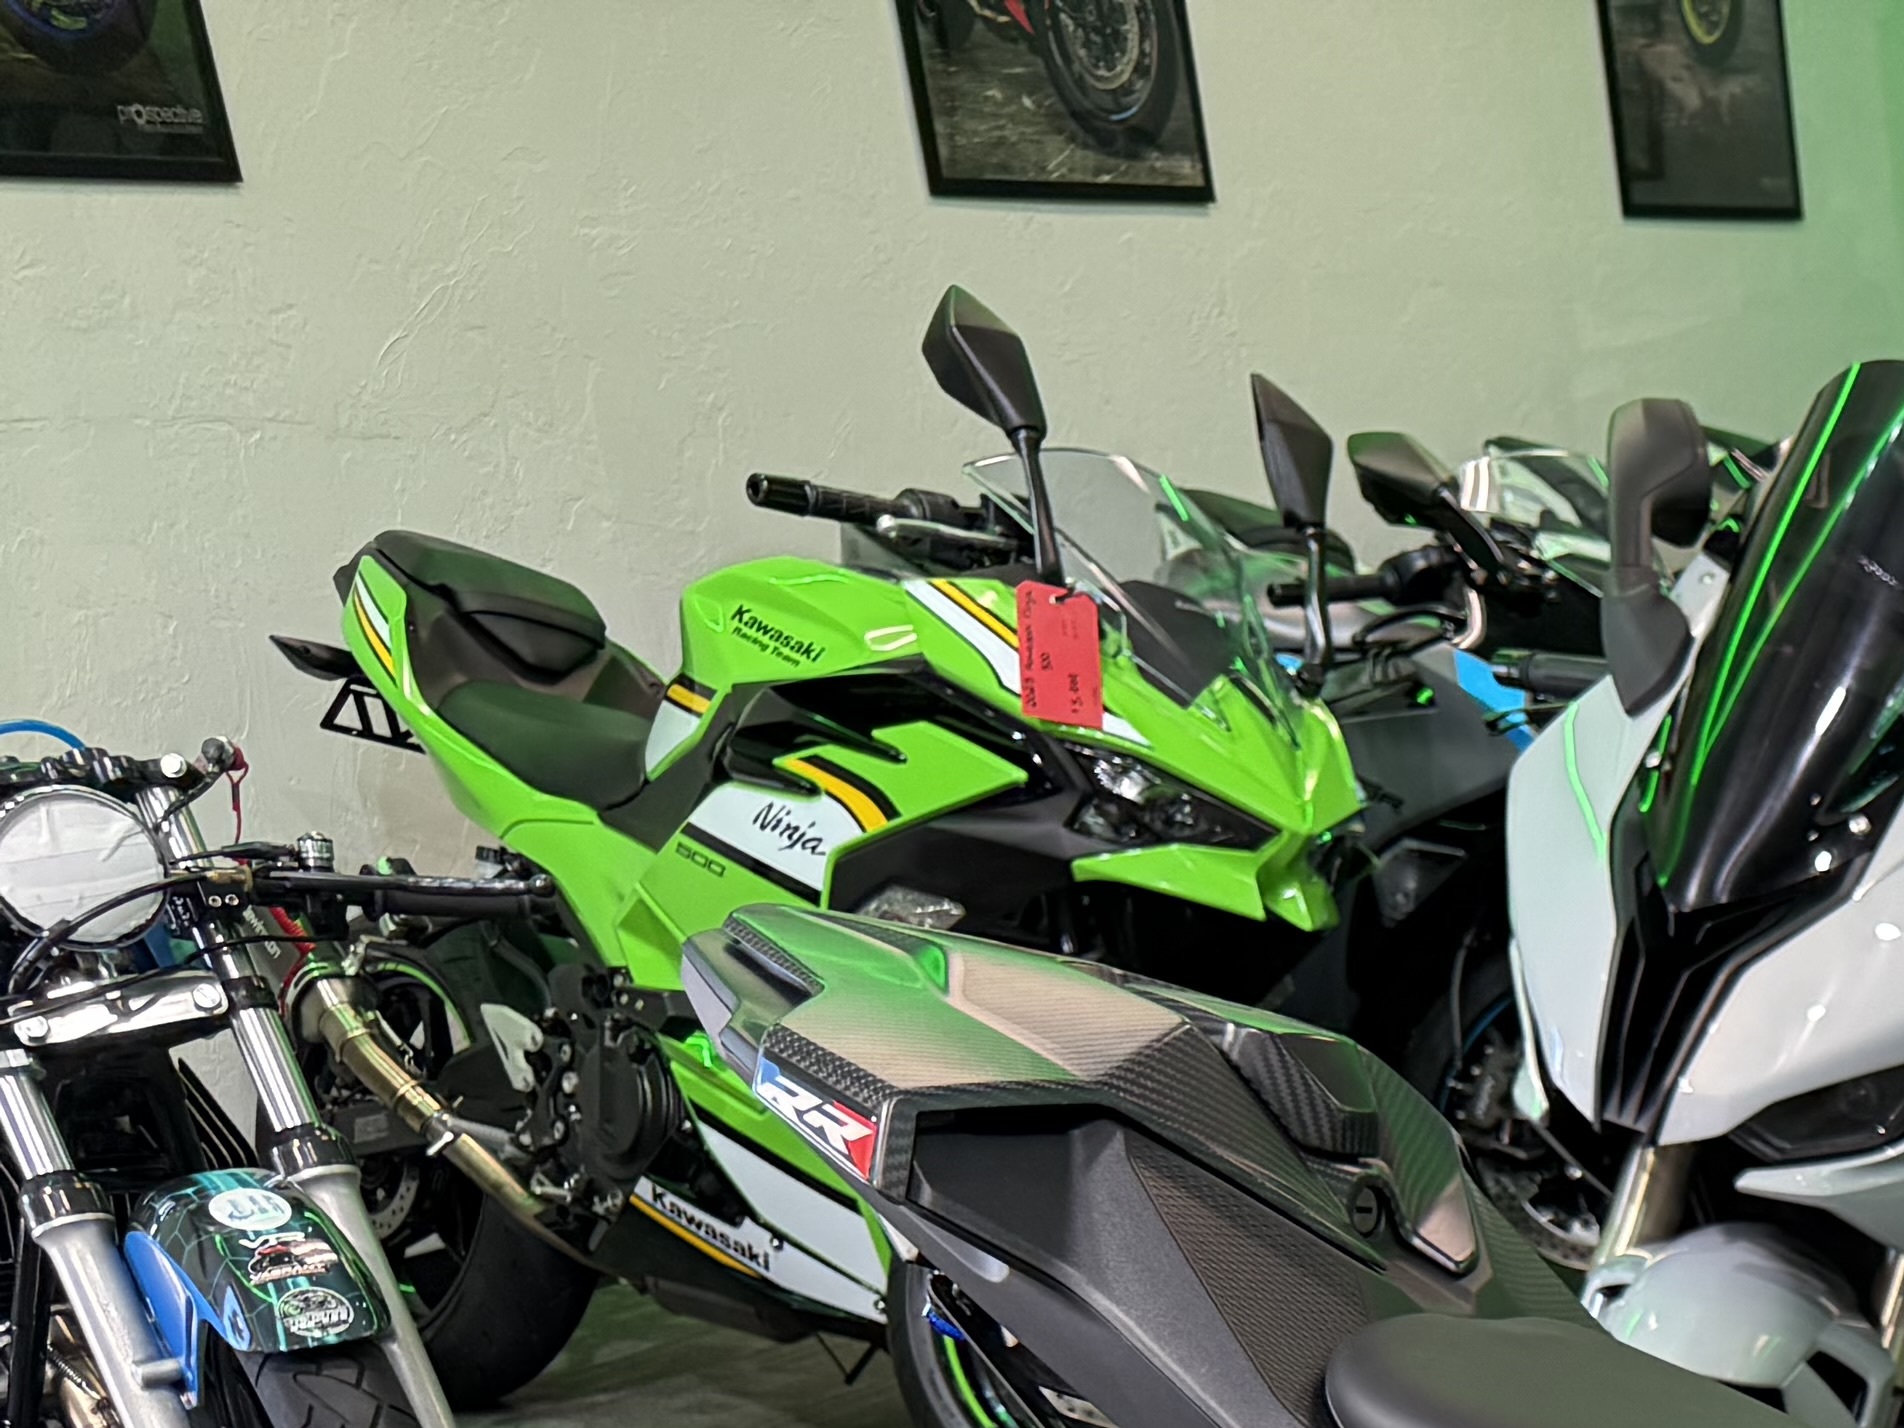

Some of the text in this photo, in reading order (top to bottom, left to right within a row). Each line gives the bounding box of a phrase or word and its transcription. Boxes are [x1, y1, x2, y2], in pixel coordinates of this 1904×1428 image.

[730, 604, 826, 664] Kawasaki
[731, 626, 801, 668] Racing Team
[752, 800, 828, 856] Ninja
[756, 1074, 875, 1156] RR
[651, 1184, 771, 1273] Kawasaki
